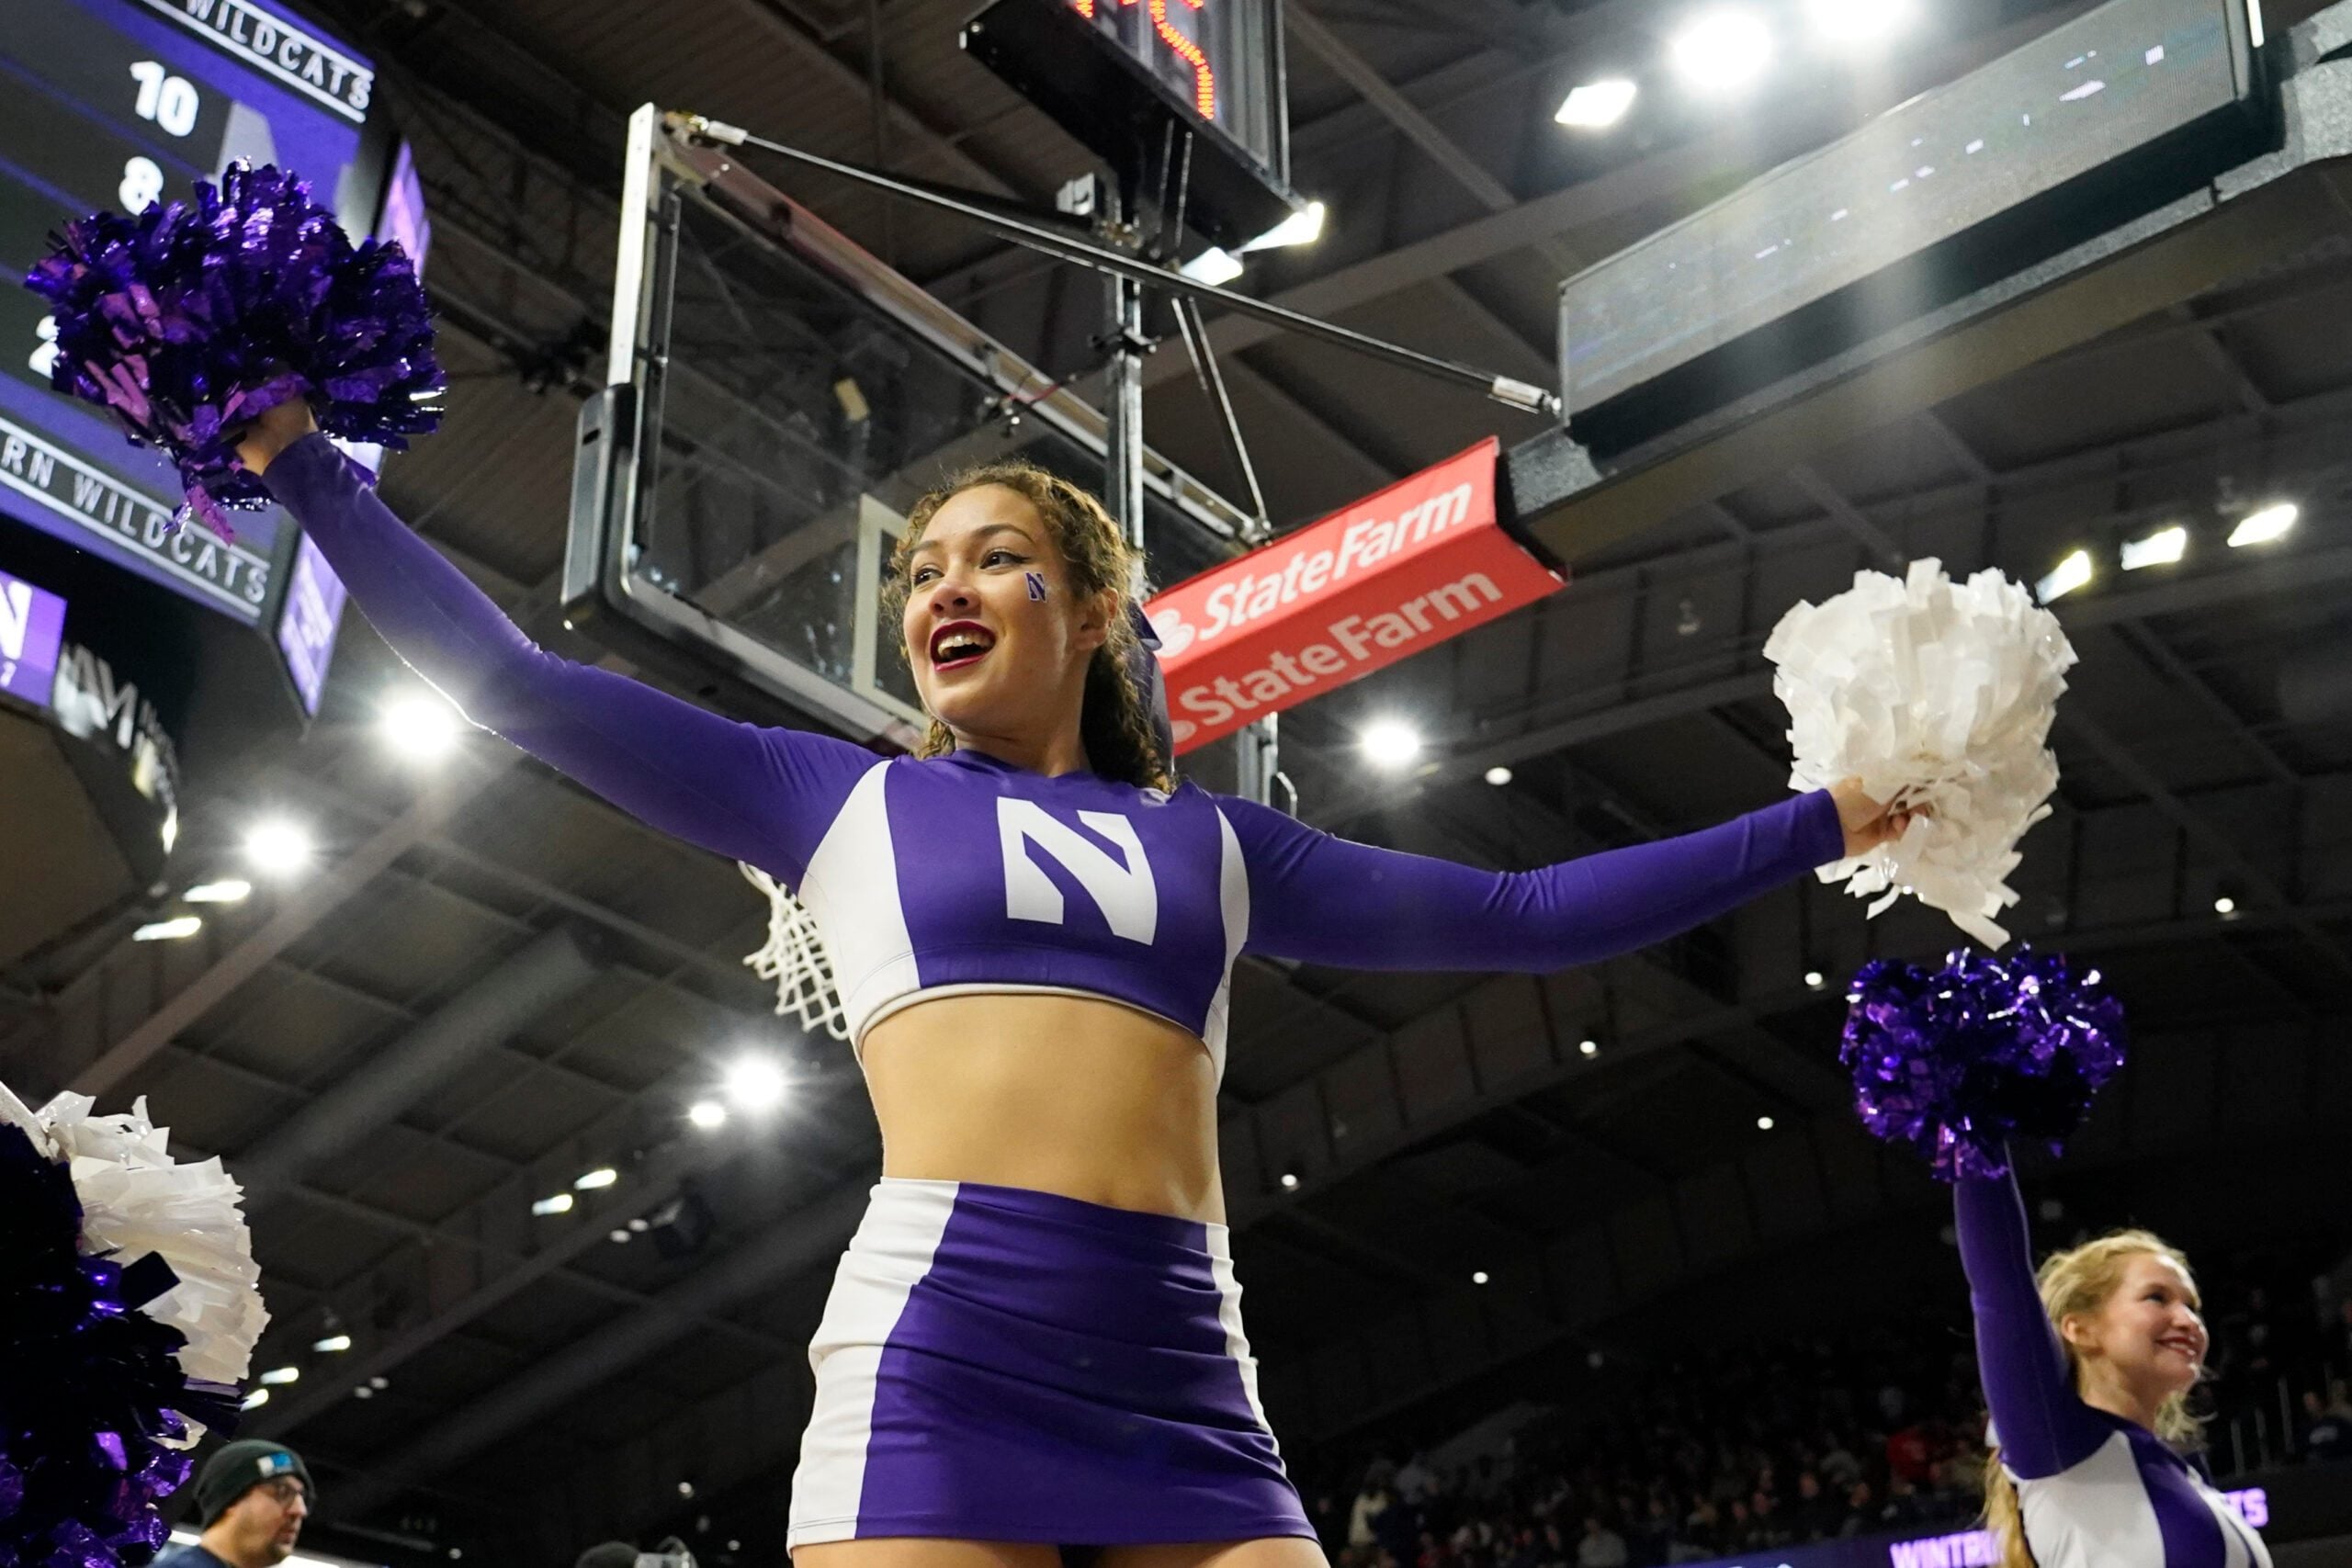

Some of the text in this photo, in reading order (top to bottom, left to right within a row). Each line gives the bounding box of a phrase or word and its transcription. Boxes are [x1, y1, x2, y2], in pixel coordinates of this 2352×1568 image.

[130, 61, 199, 137] 10
[186, 0, 372, 110] WILDCATS
[119, 156, 164, 216] 8
[74, 472, 268, 604] WILDCATS
[1025, 571, 1047, 604] N
[997, 796, 1158, 946] N
